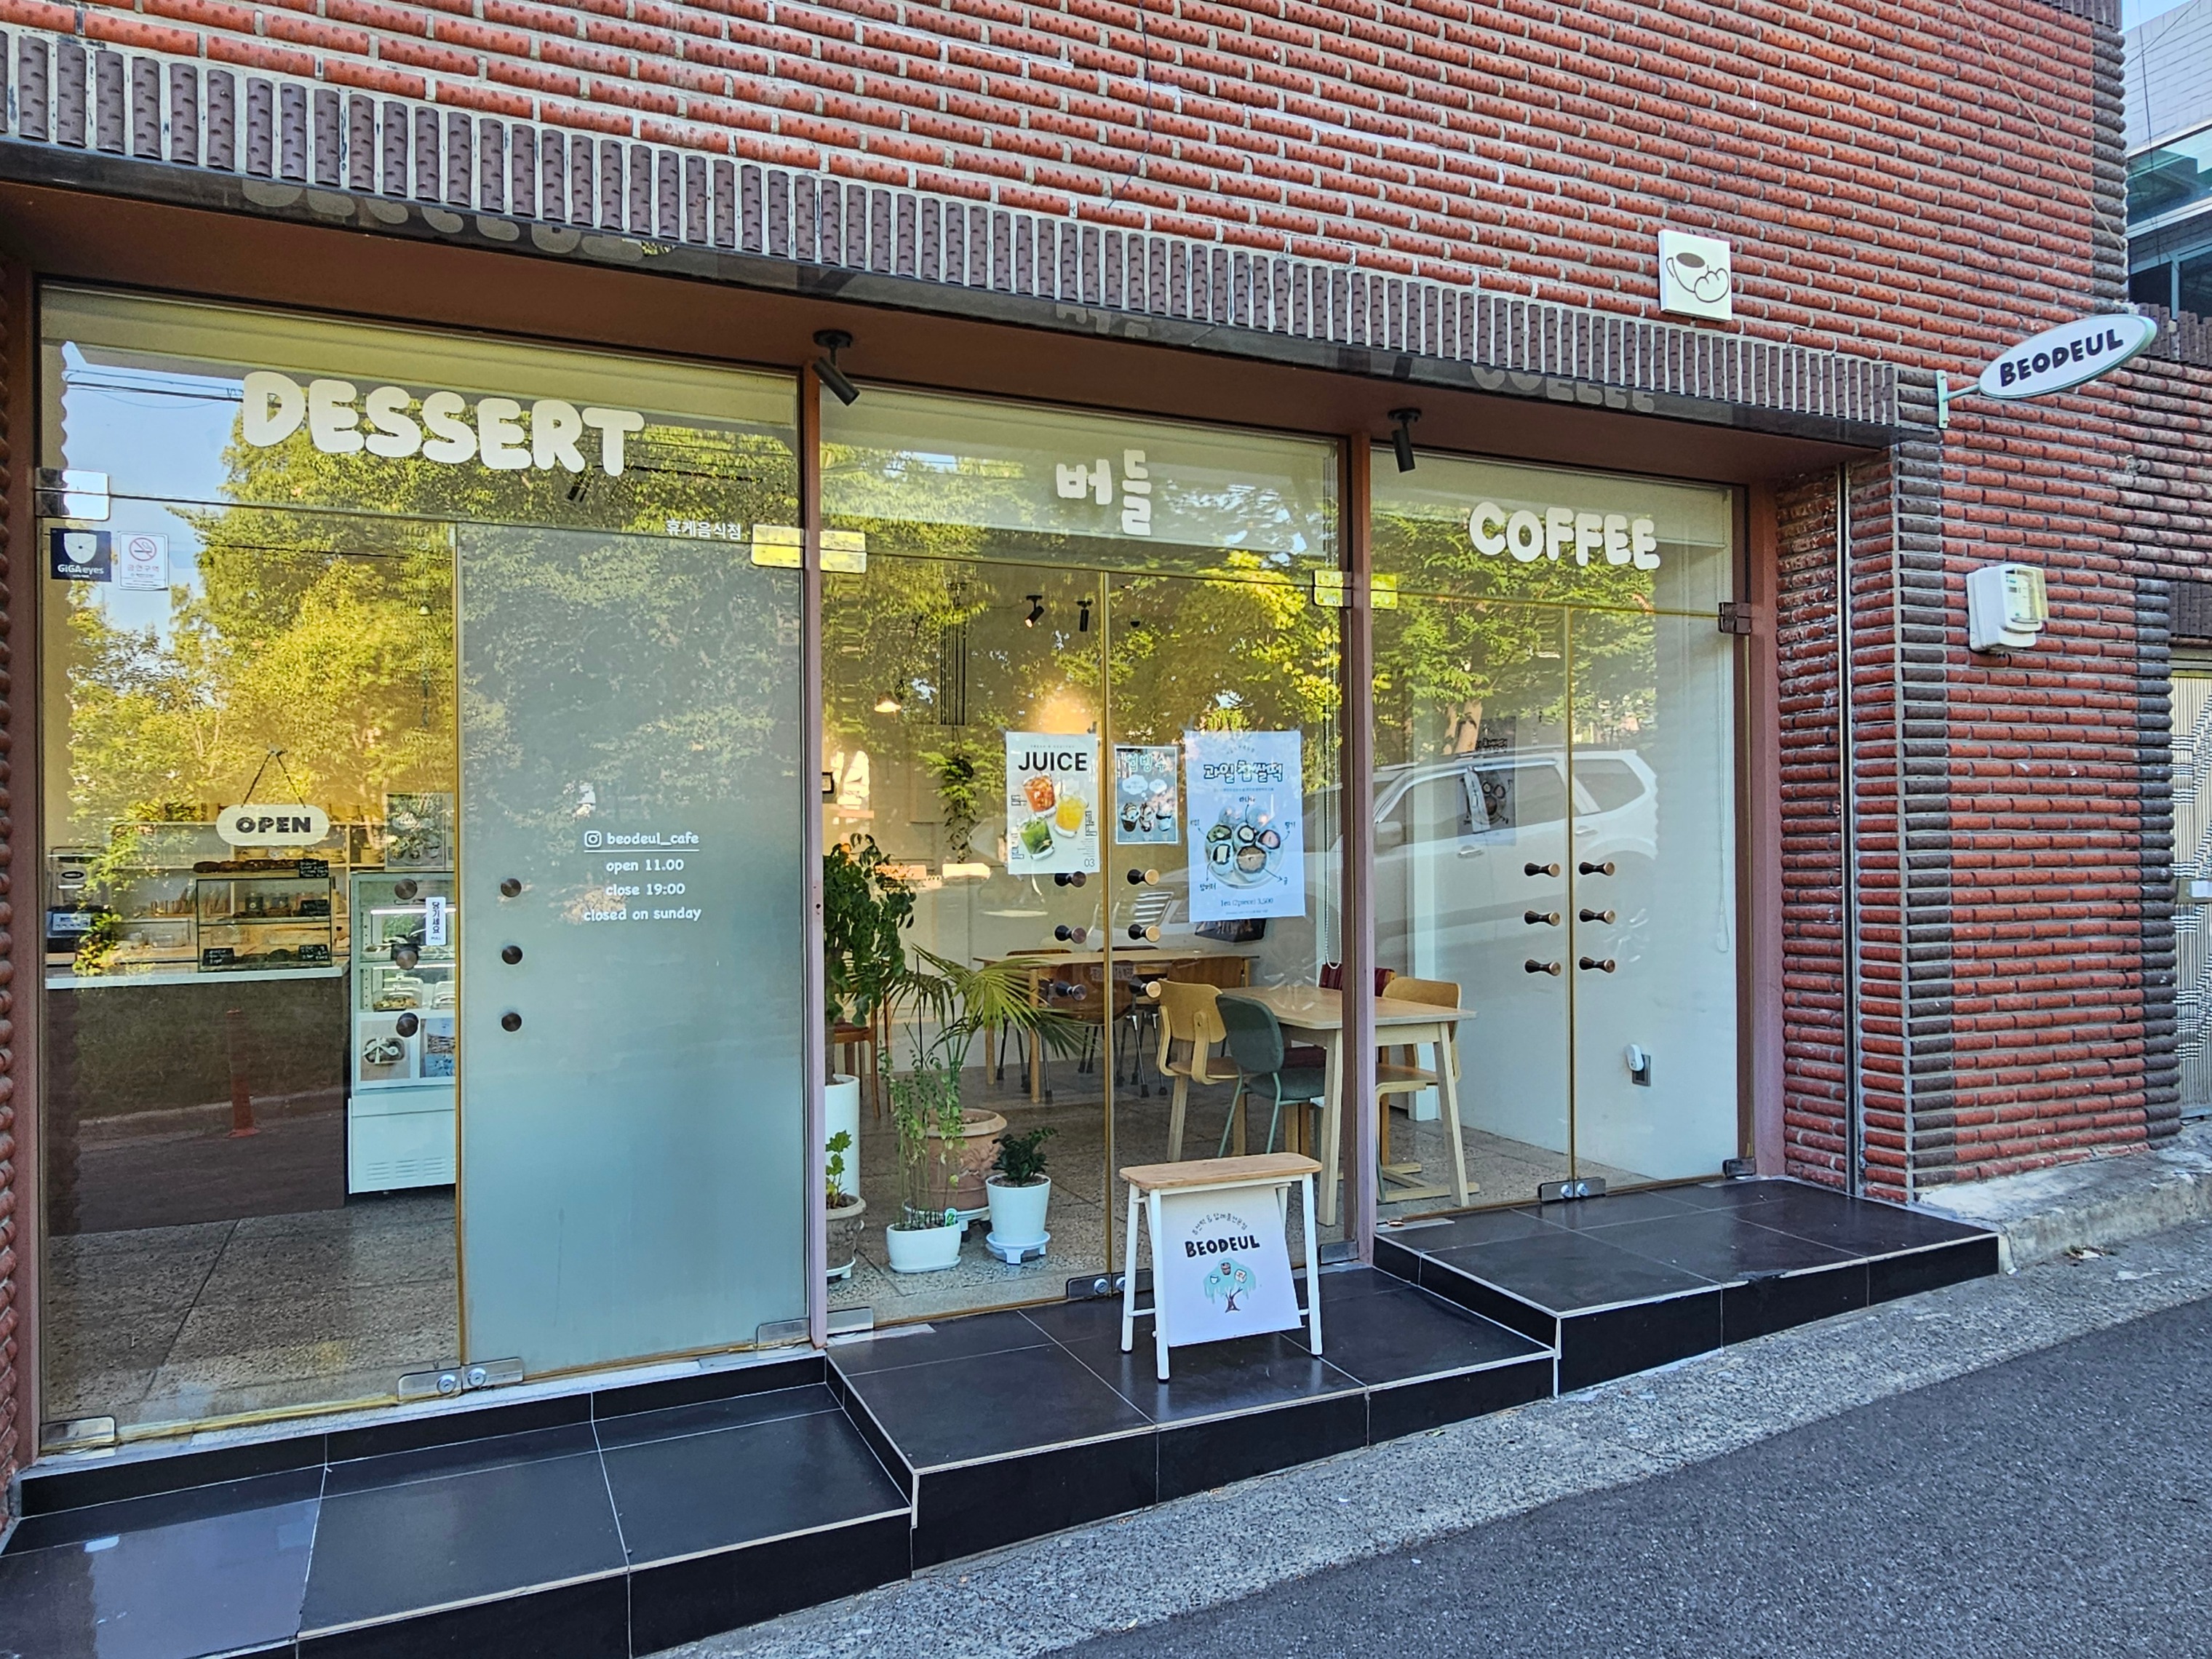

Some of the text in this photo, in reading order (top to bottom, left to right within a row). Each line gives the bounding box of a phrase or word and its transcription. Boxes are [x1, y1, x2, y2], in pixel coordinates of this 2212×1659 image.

[2000, 329, 2124, 387] BEODEUL
[243, 370, 645, 477] DESSERT
[1056, 448, 1152, 536] 버들
[666, 518, 735, 540] 휴게음식점
[1469, 501, 1661, 570] COFFEE
[82, 567, 104, 575] eyes
[1018, 752, 1088, 771] JUICE
[1204, 759, 1284, 784] 과일 찹쌀떡
[236, 816, 311, 834] OPEN
[607, 831, 699, 846] beodeul_cafe
[606, 859, 685, 875] open 11.00
[1084, 858, 1095, 867] 03
[605, 883, 685, 896] close 19:00
[584, 906, 701, 922] closed on sunday
[1185, 1235, 1261, 1257] BEODEUL
